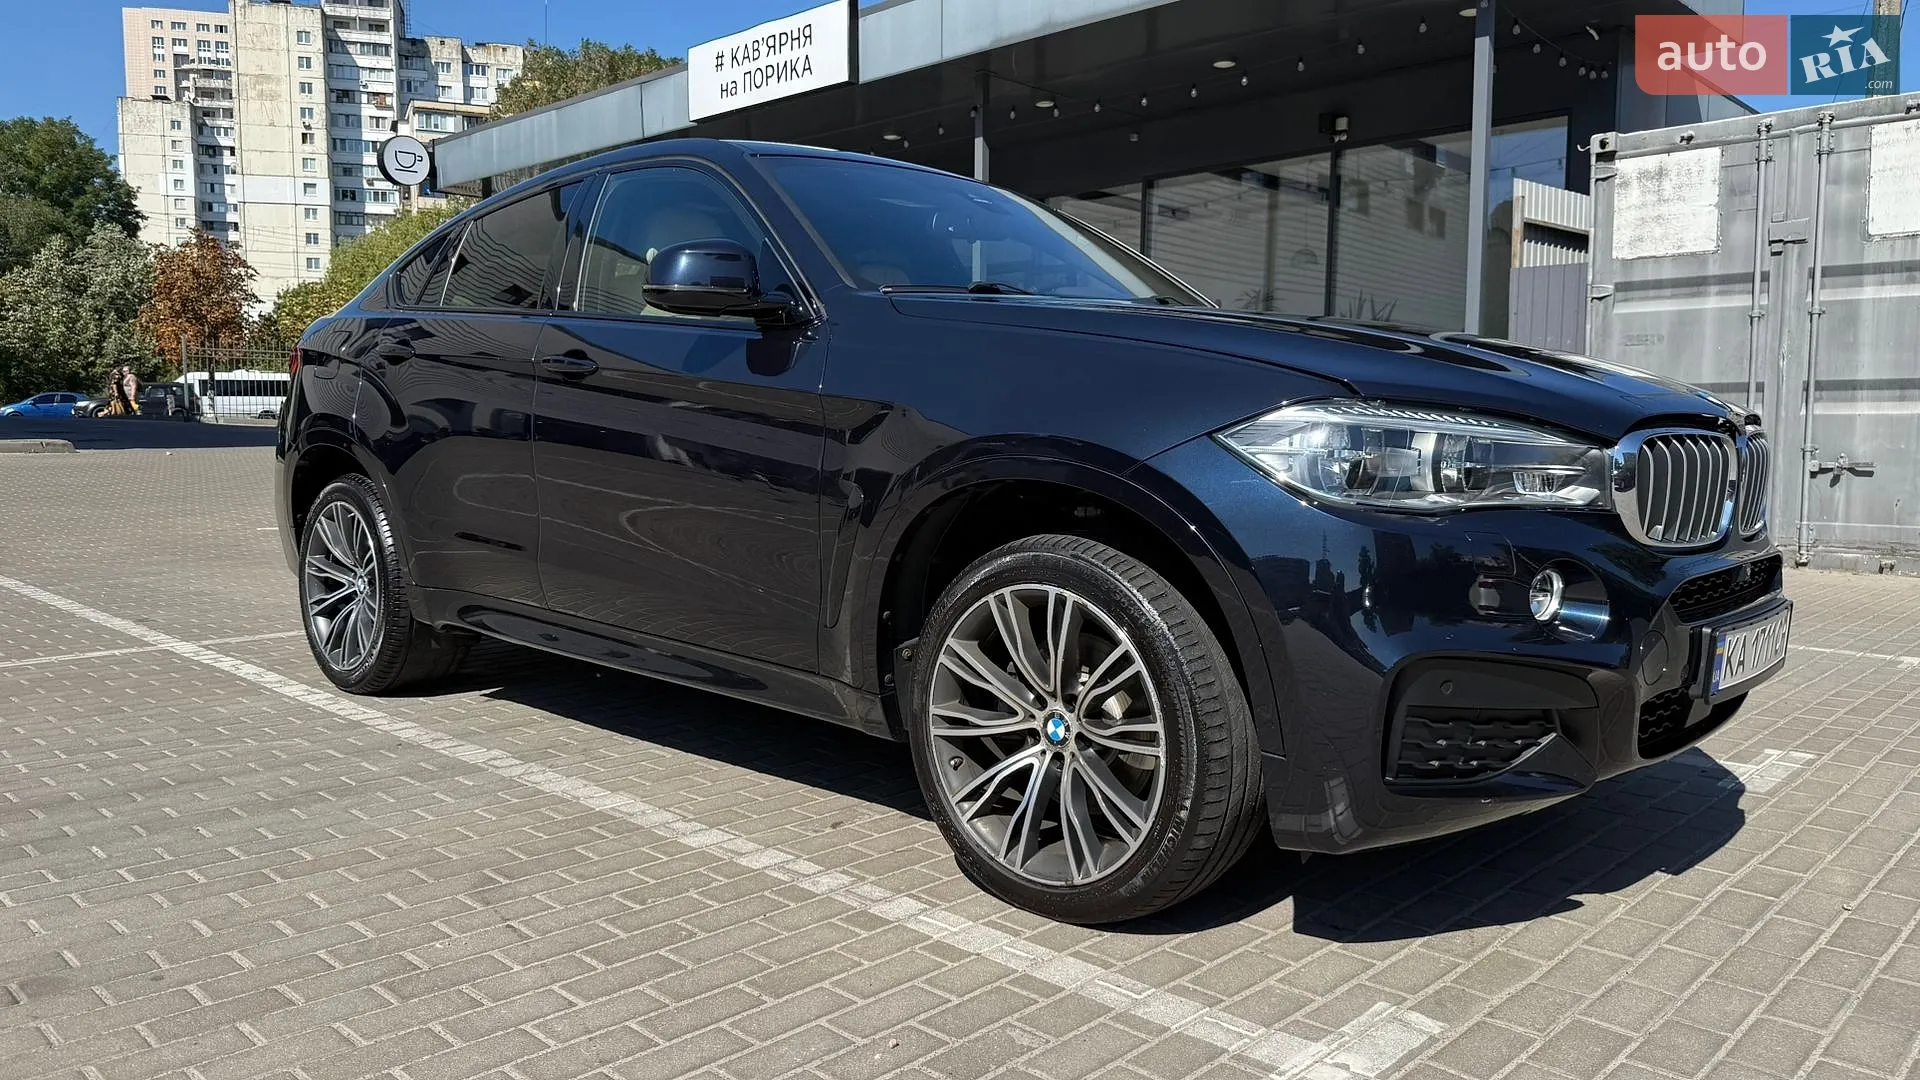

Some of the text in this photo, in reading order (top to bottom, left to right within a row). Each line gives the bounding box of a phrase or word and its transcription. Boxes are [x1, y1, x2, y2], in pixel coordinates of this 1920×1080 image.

[715, 23, 813, 72] # КАВ’ЯРНЯ
[720, 54, 813, 99] на ПОРИКА
